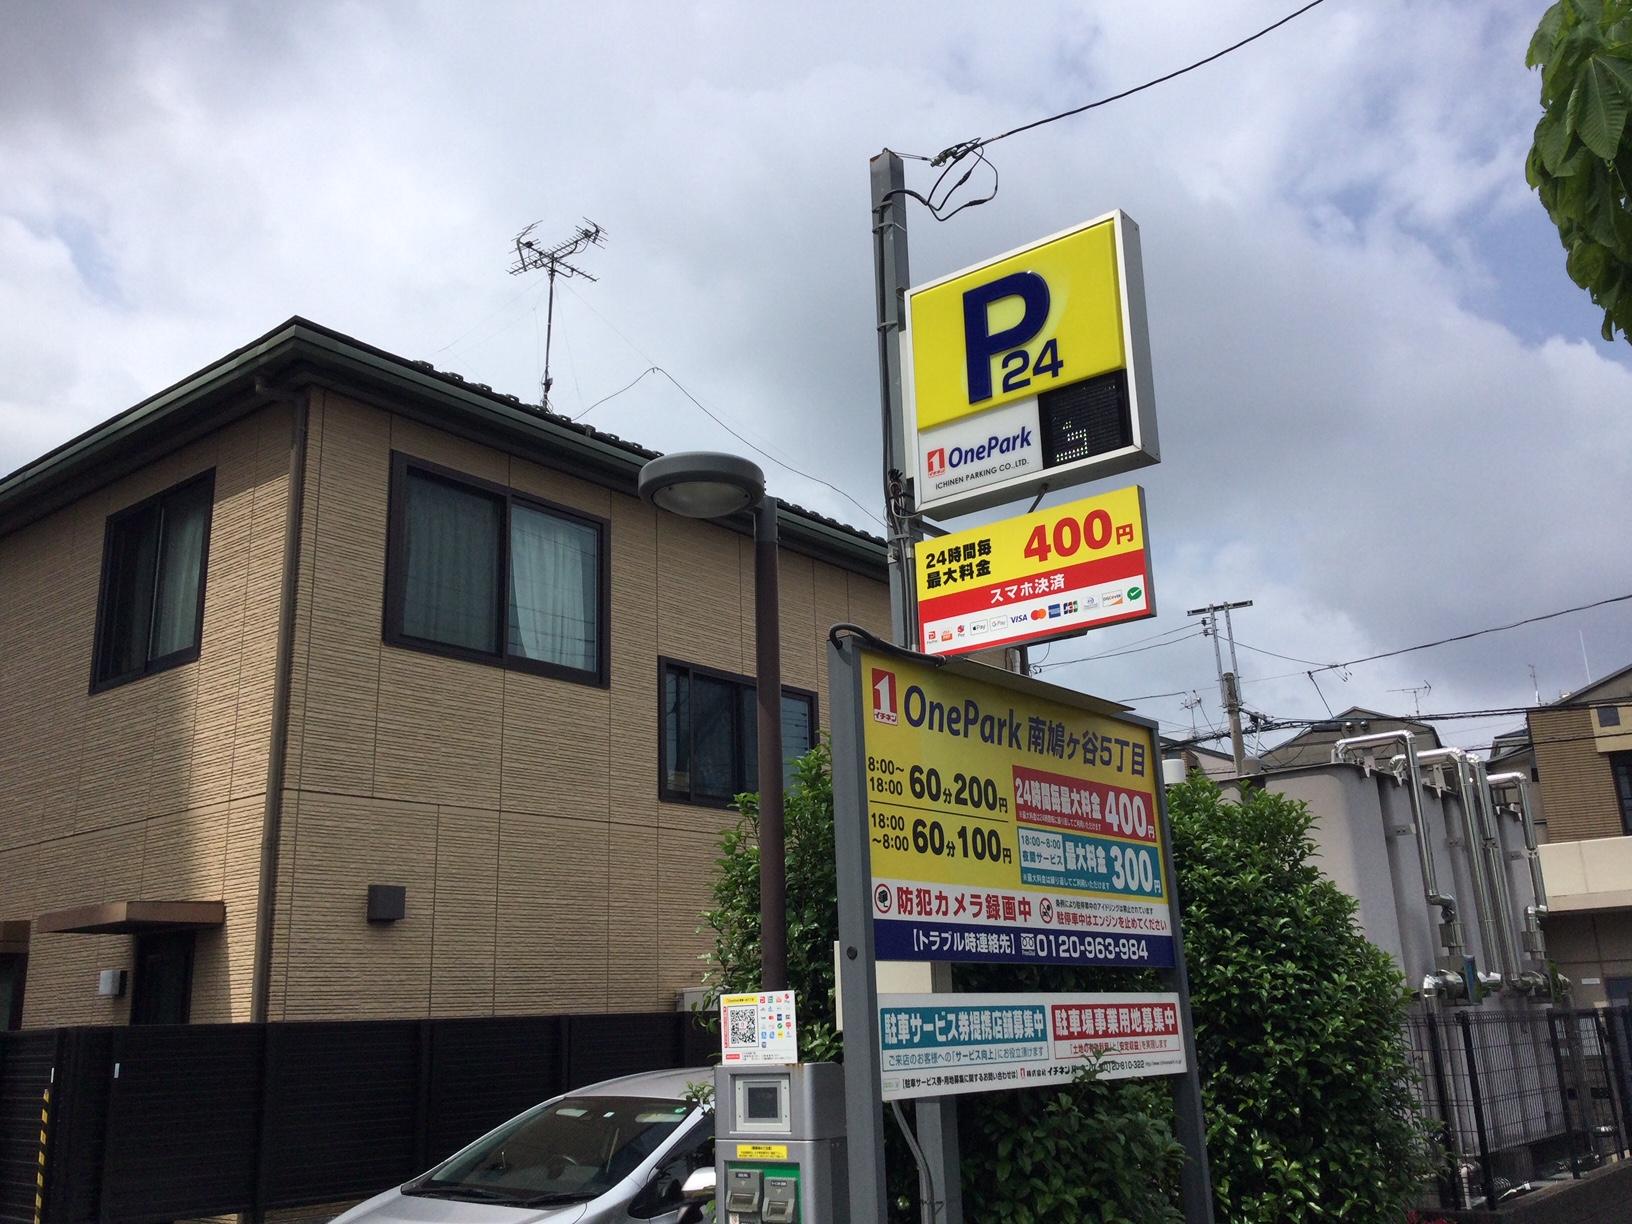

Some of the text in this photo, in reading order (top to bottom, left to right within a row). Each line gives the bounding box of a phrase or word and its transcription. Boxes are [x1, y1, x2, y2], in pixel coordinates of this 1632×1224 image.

[963, 271, 1050, 405] P
[1001, 338, 1064, 393] 24
[948, 426, 1032, 468] OnePark
[935, 476, 964, 490] ICHINEN
[965, 466, 997, 481] PARKING
[1023, 508, 1134, 563] 400円
[925, 538, 992, 569] 24時間毎
[926, 559, 991, 590] 最大料金
[990, 573, 1065, 604] スマホ決済
[1010, 614, 1028, 624] VISA
[874, 711, 897, 723] イチネン
[904, 685, 1022, 750] OnePark
[869, 776, 903, 796] 18:00
[871, 812, 905, 831] 18:00
[1104, 791, 1155, 839] 400円
[1022, 851, 1063, 866] 夜間サービス
[1065, 841, 1162, 893] 最大料金 300円
[896, 886, 1032, 923] 防犯カメラ録画中
[1056, 911, 1167, 930] 駐停車中はエンジンを止めてください
[912, 928, 1149, 960] 【トラブル時連絡先】 0120-963-984
[884, 1009, 1044, 1045] 駐車サービス券提携店舗募集中
[1054, 1006, 1176, 1036] 駐車場事業用地募集中
